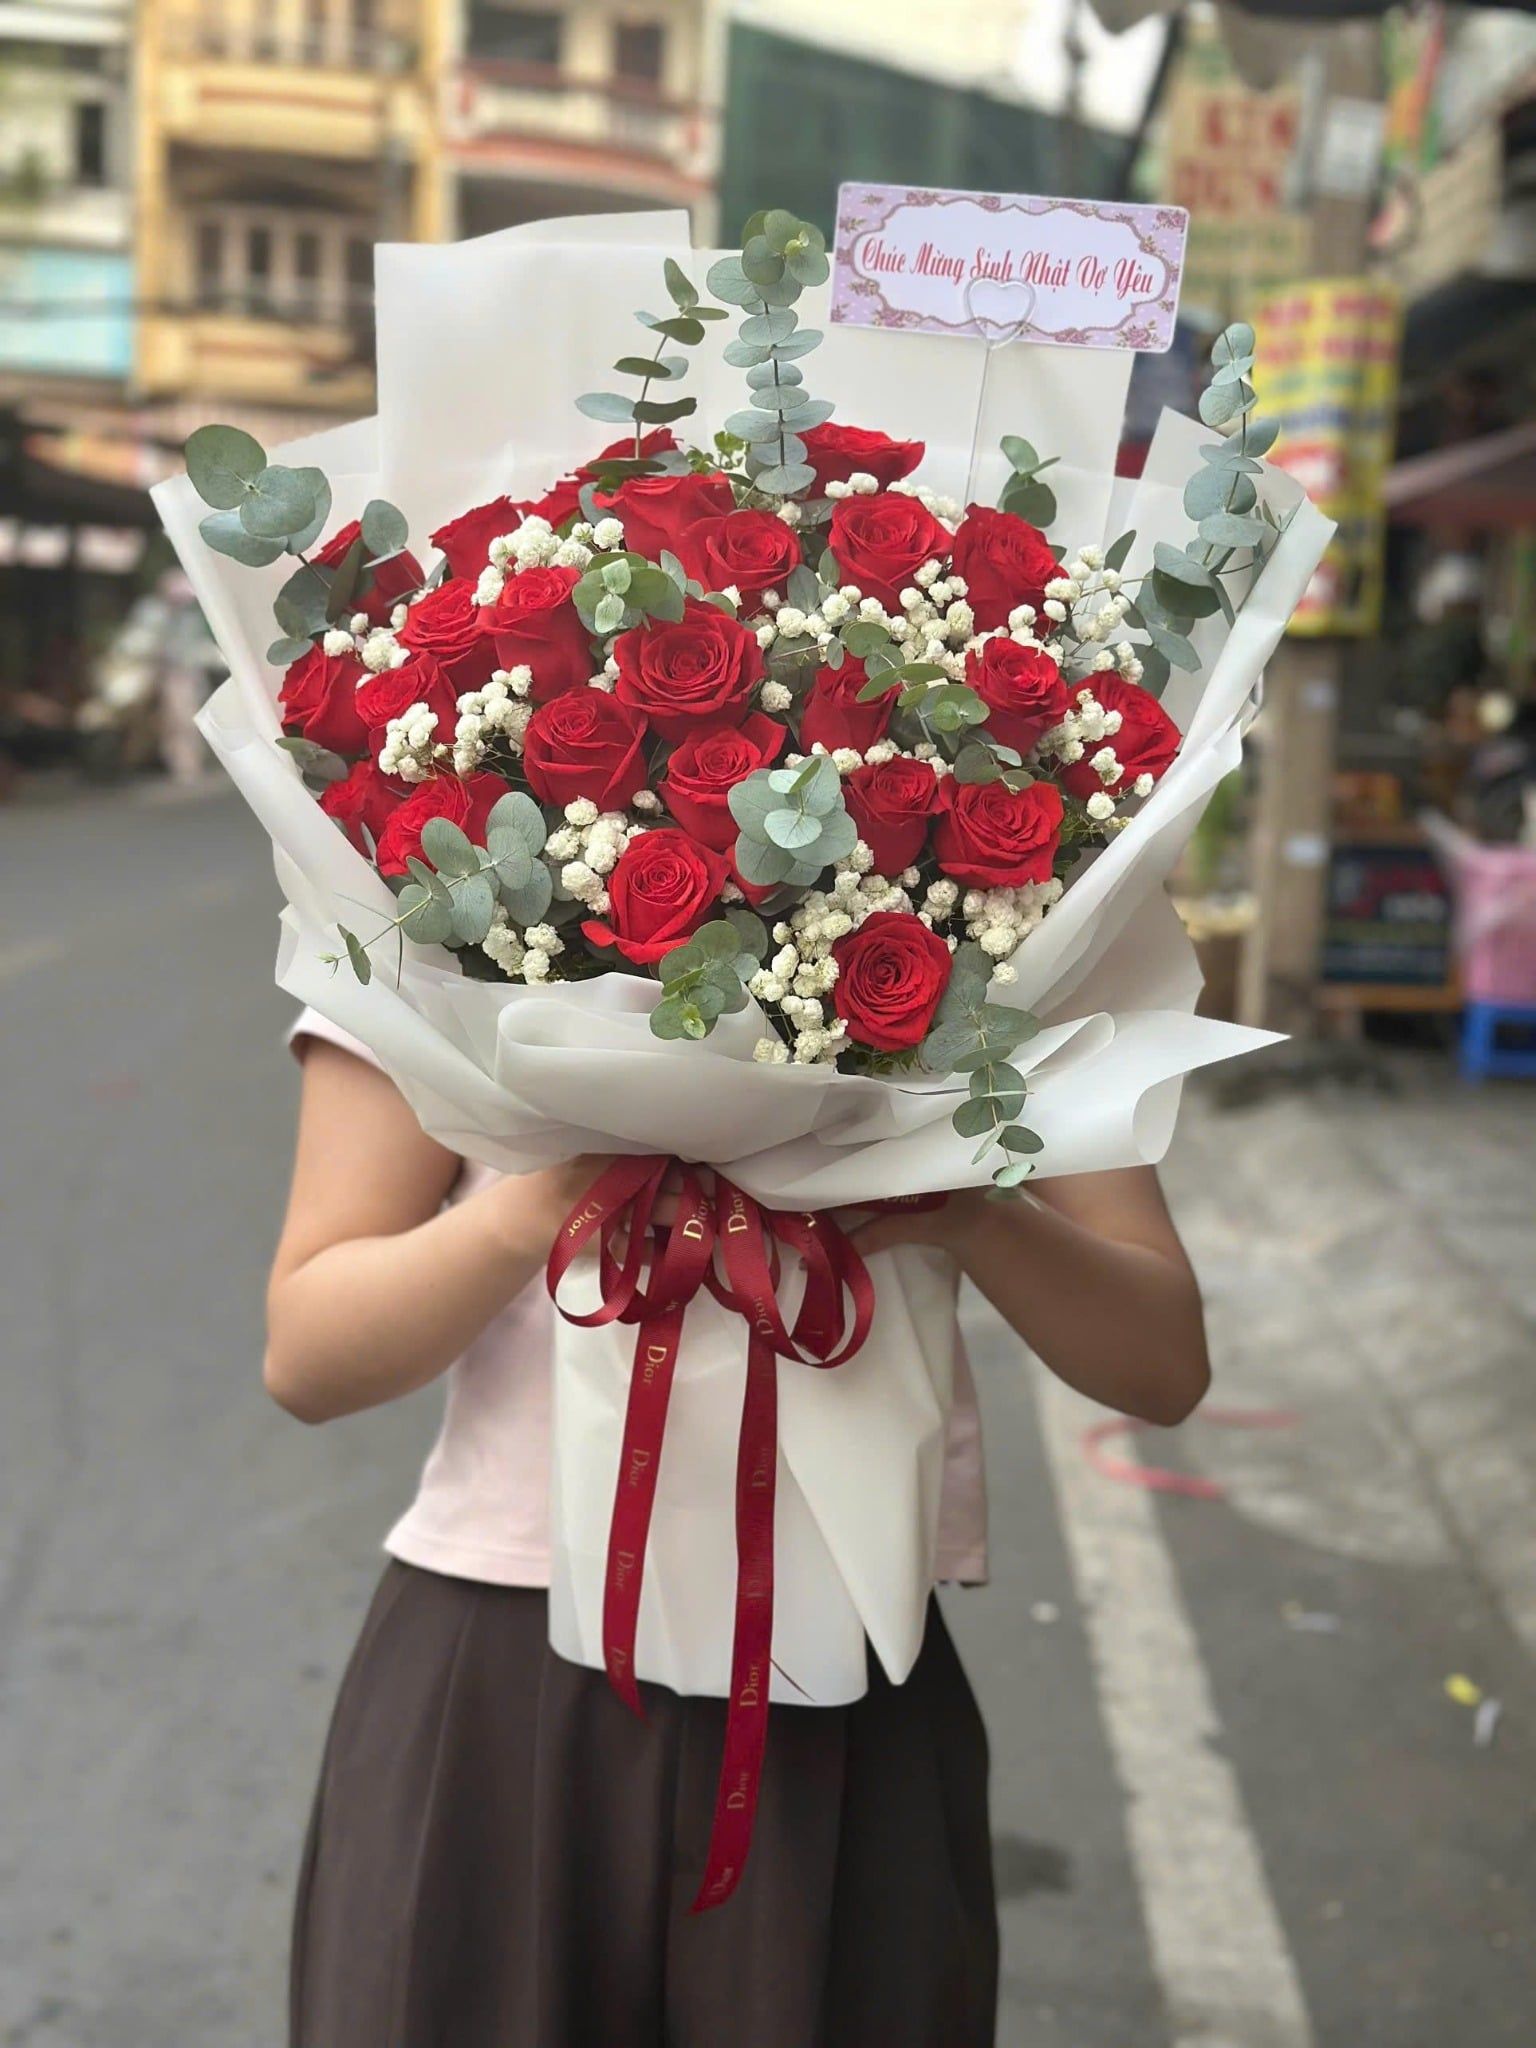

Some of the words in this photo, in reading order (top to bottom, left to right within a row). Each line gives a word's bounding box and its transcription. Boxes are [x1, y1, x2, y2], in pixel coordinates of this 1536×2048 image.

[862, 237, 906, 273] Chúc
[909, 241, 965, 286] Mừng
[970, 246, 1013, 281] Sinh
[1019, 250, 1072, 293] Nhật
[1076, 255, 1109, 296] Vợ
[1113, 258, 1154, 300] Yêu
[568, 1200, 604, 1237] Dior
[682, 1199, 710, 1242] Dior
[727, 1193, 748, 1233] Dior
[643, 1345, 667, 1384] Dior
[629, 1448, 650, 1487] Dior
[615, 1550, 635, 1592] Dior
[739, 1664, 760, 1707] Dior
[726, 1772, 750, 1809] Dior
